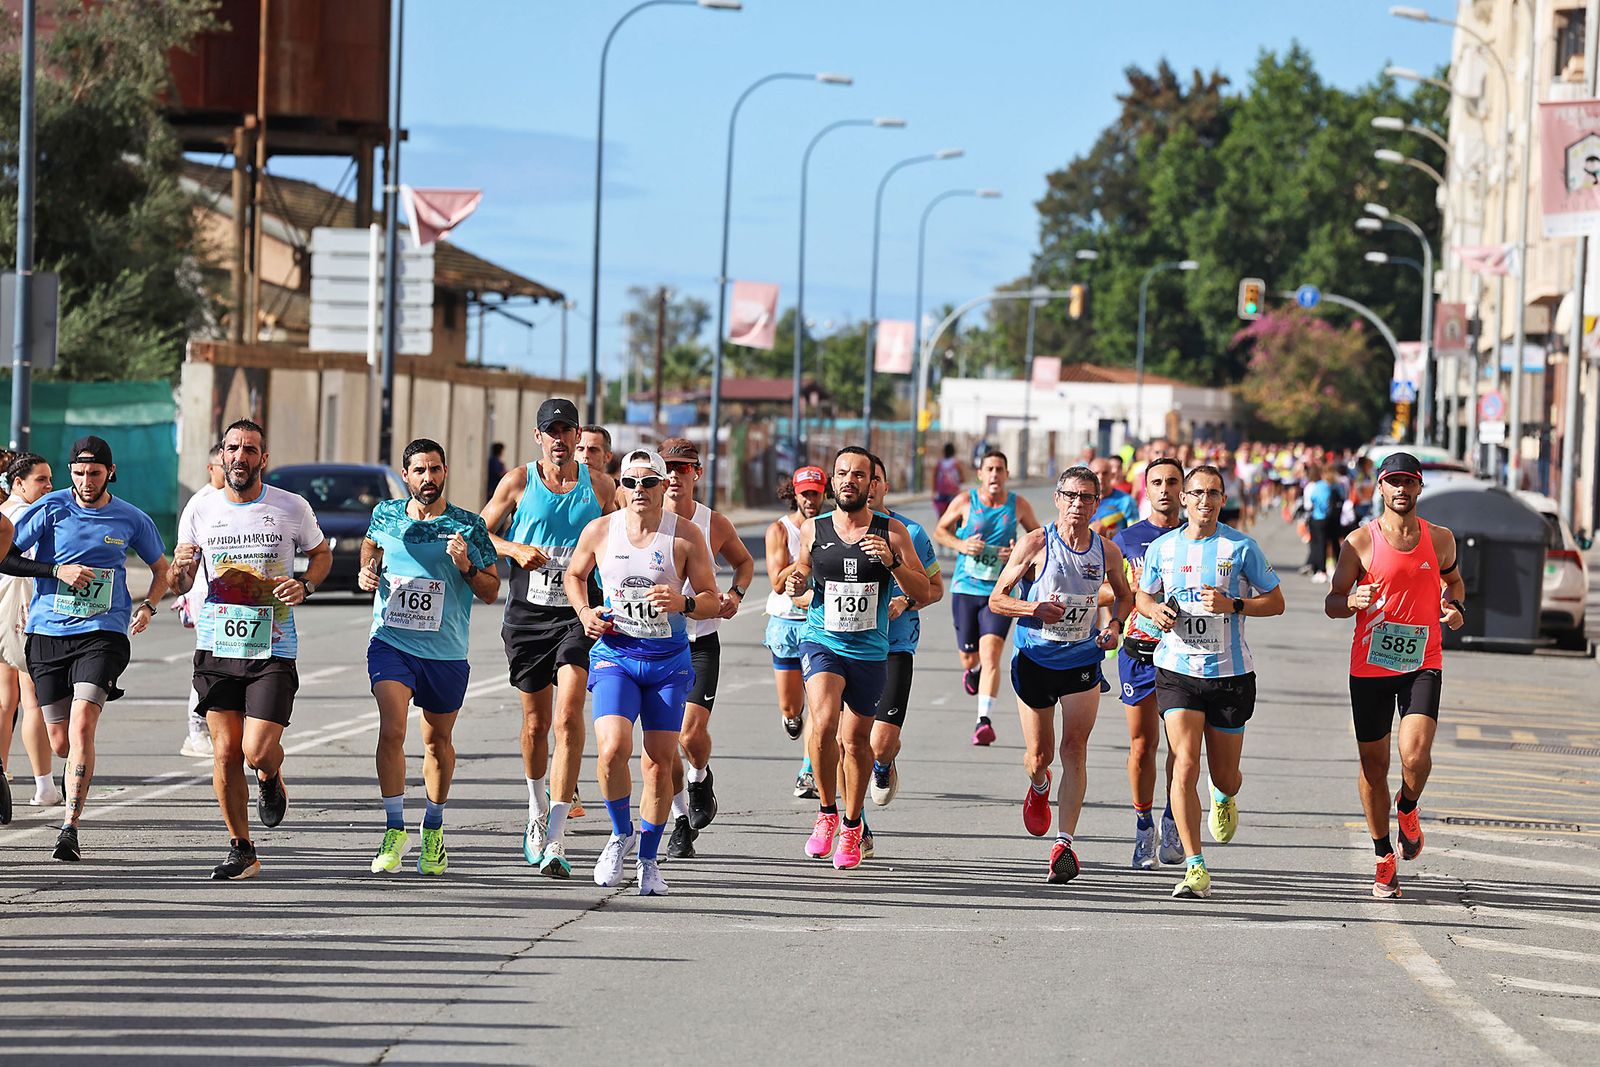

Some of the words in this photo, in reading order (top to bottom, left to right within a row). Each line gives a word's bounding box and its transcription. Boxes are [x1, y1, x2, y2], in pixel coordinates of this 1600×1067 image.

[207, 537, 216, 546] IV
[217, 533, 241, 545] MEDIA
[243, 531, 283, 544] MARATÓN
[243, 552, 279, 560] MARISMAS
[973, 554, 998, 567] 462
[101, 570, 111, 579] 2K
[67, 581, 104, 598] 437
[428, 581, 441, 591] 2K
[828, 583, 838, 592] 2K
[864, 584, 875, 593] 2K
[615, 589, 625, 599] 2K
[1050, 594, 1061, 602] 2K
[398, 591, 432, 611] 168
[834, 596, 868, 613] 130
[1085, 595, 1095, 604] 2K
[219, 606, 229, 614] 2K
[258, 608, 269, 617] 2K
[386, 614, 410, 625] Huelva
[1058, 607, 1089, 624] 47
[225, 620, 262, 639] 667
[1183, 617, 1207, 635] 10
[1376, 621, 1389, 633] 2K
[1414, 626, 1426, 636] 2K
[1196, 637, 1219, 645] PADILLA
[1380, 635, 1418, 655] 585
[1370, 655, 1394, 666] Huelva
